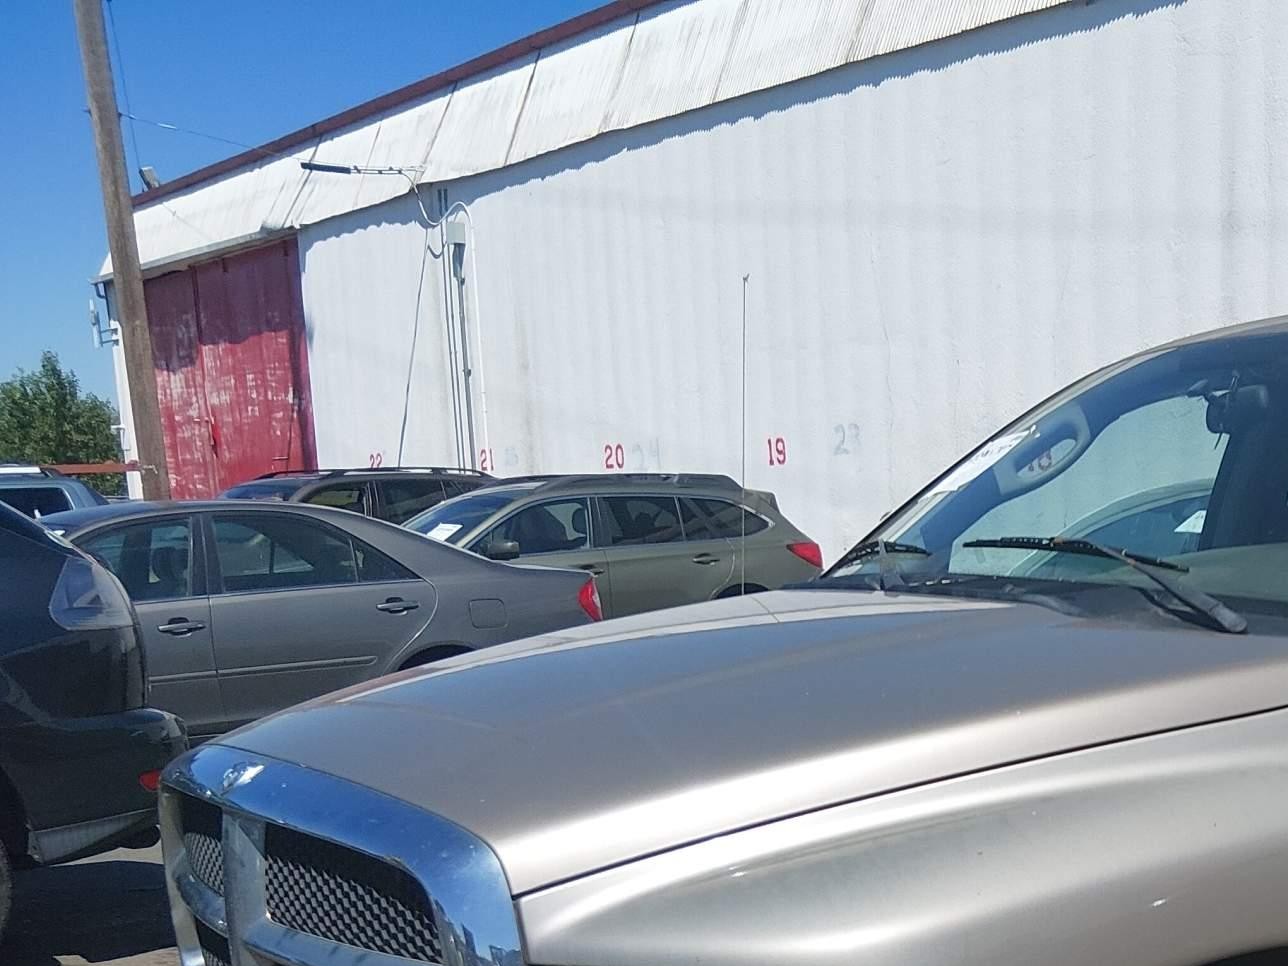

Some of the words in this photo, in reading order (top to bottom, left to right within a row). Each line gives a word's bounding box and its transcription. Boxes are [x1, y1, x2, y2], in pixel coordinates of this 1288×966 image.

[480, 448, 494, 471] 21
[604, 444, 624, 469] 20
[767, 438, 786, 466] 19
